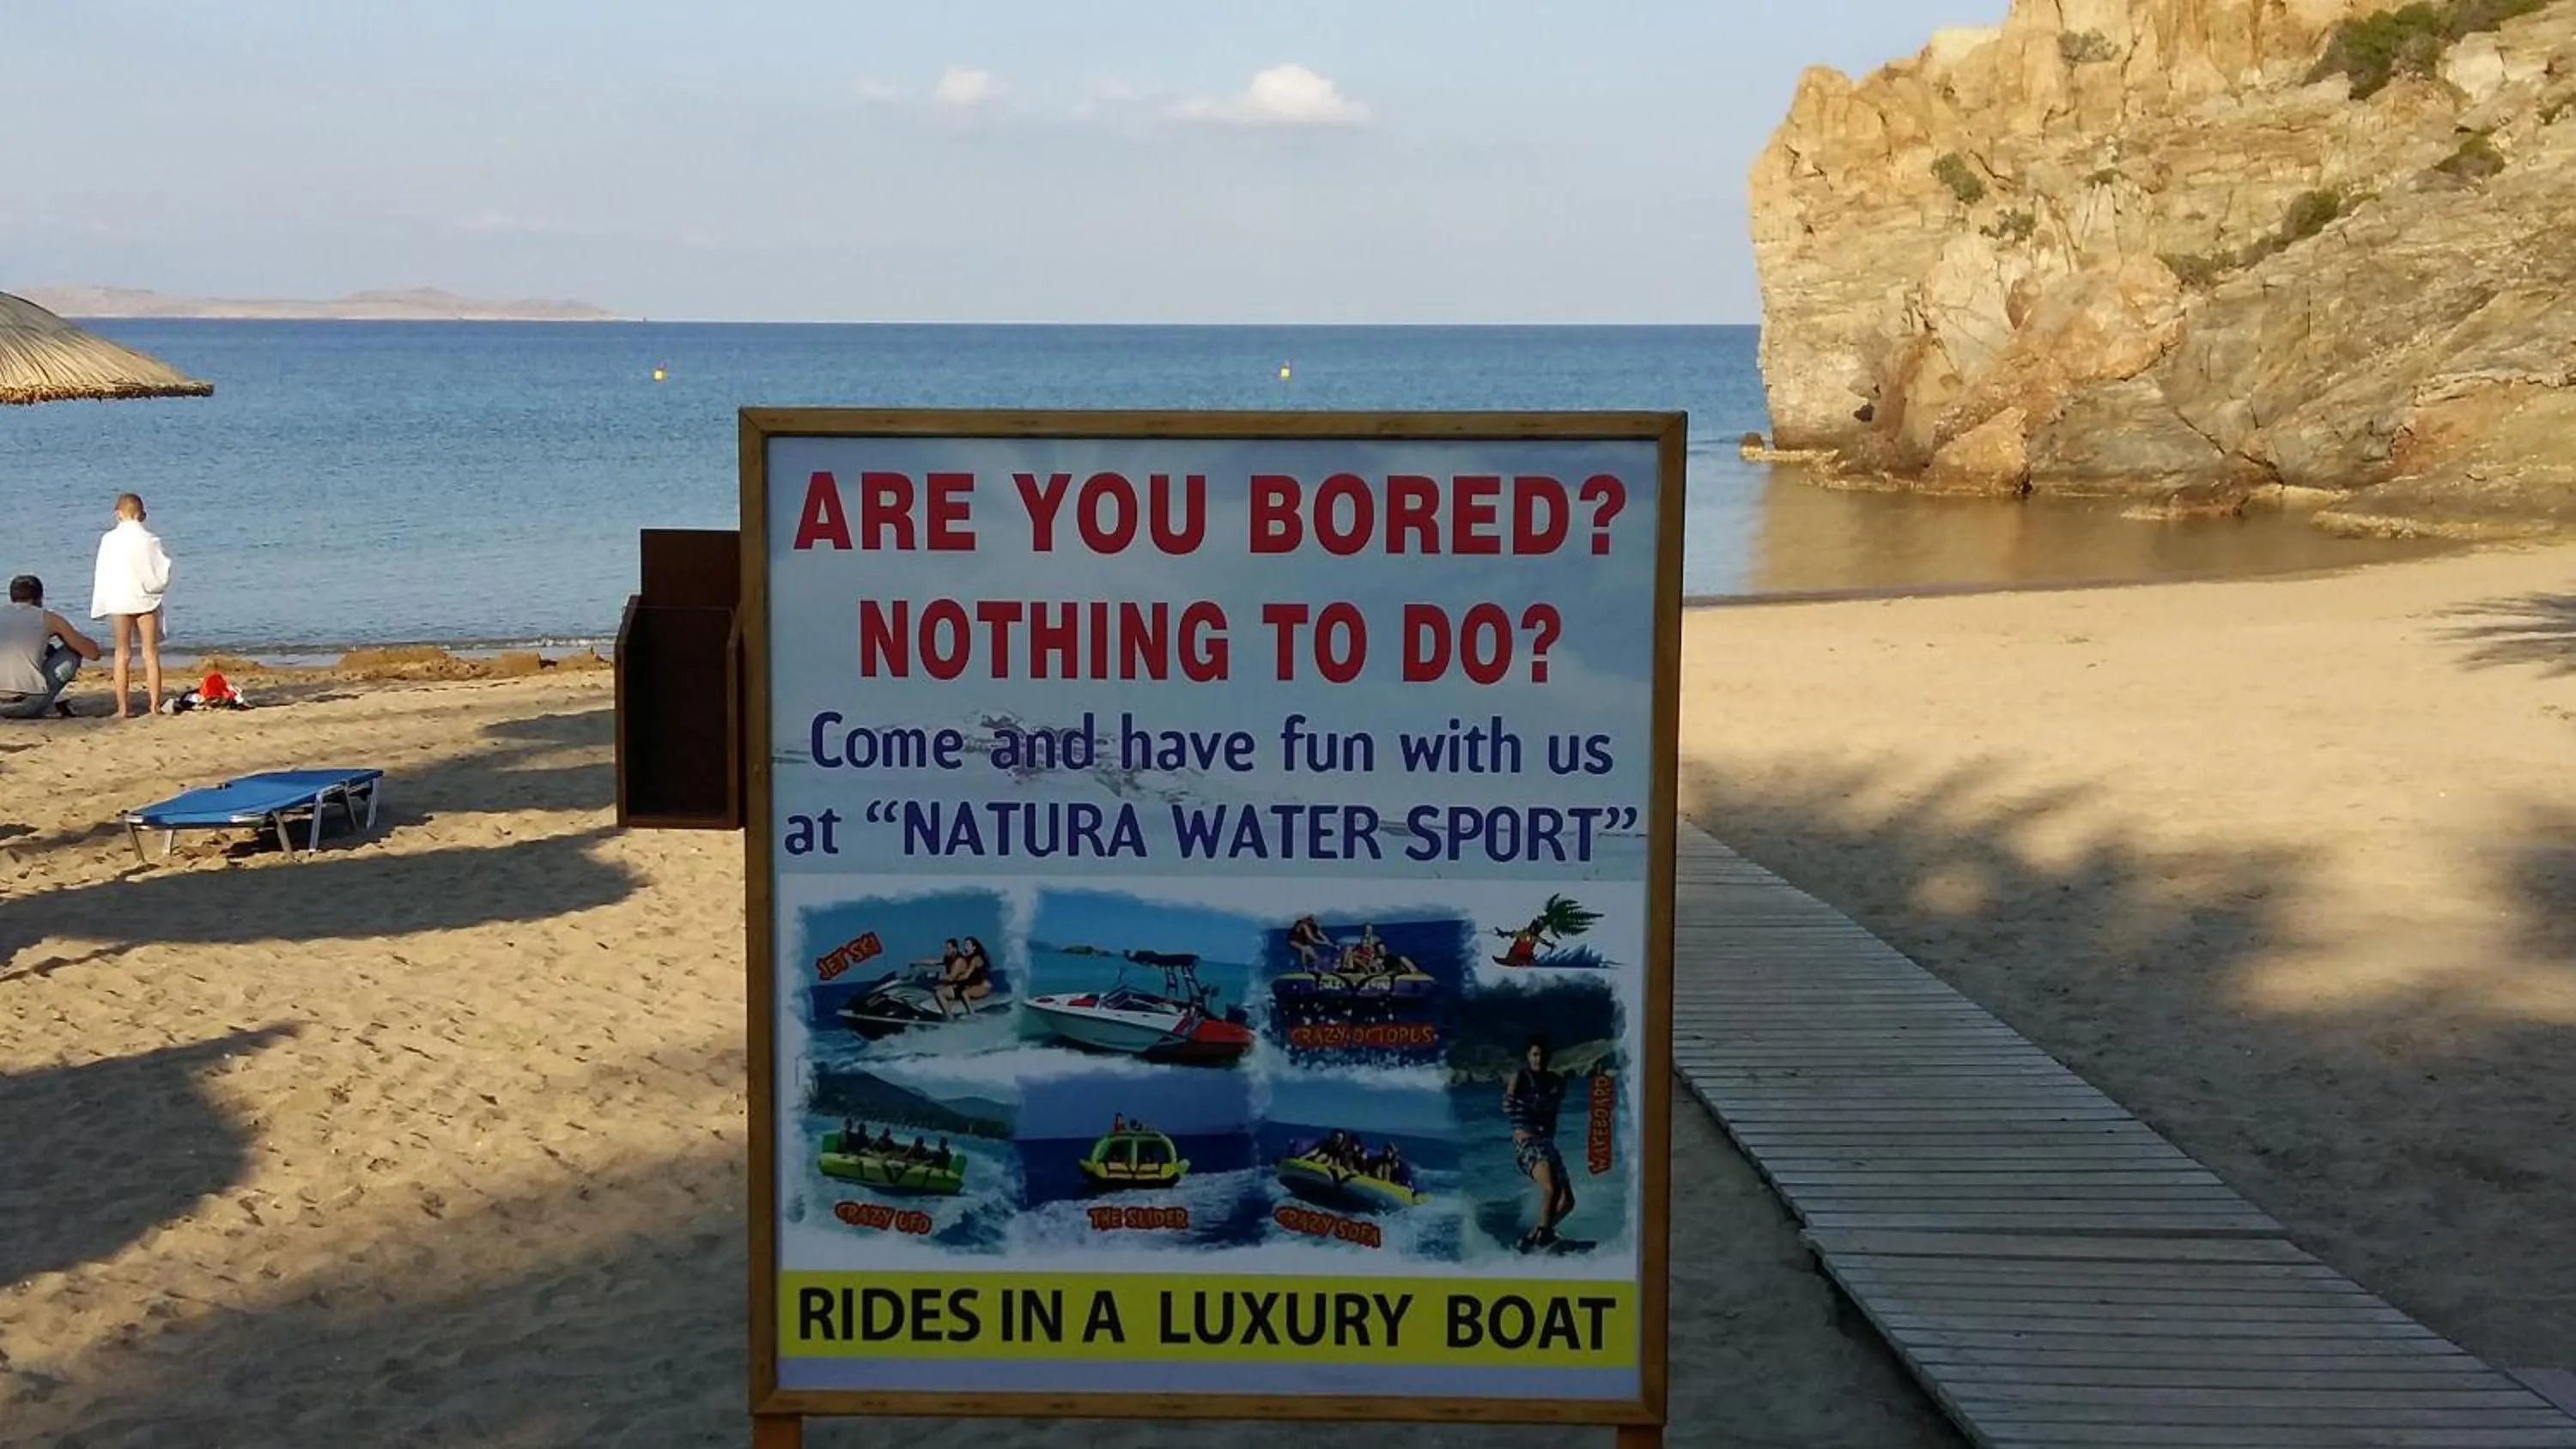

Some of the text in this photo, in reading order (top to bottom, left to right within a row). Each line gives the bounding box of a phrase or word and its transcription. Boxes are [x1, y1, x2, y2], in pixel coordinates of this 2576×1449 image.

[793, 472, 1625, 555] ARE YOU BORED?
[860, 600, 1559, 683] NOTHING TO DO?
[812, 712, 1613, 774] Come and have fun with us
[785, 809, 841, 855] at
[1172, 804, 1381, 858] WATER
[817, 932, 881, 979] JET SKI
[1291, 1024, 1434, 1046] CRAZY OCTOPUS
[835, 1203, 931, 1234] CRAZY UFO
[1089, 1207, 1188, 1228] THE SLIDER
[1274, 1206, 1380, 1246] CRAZY SOFA
[800, 1288, 1616, 1349] RIDES IN A LUXURY BOAT
